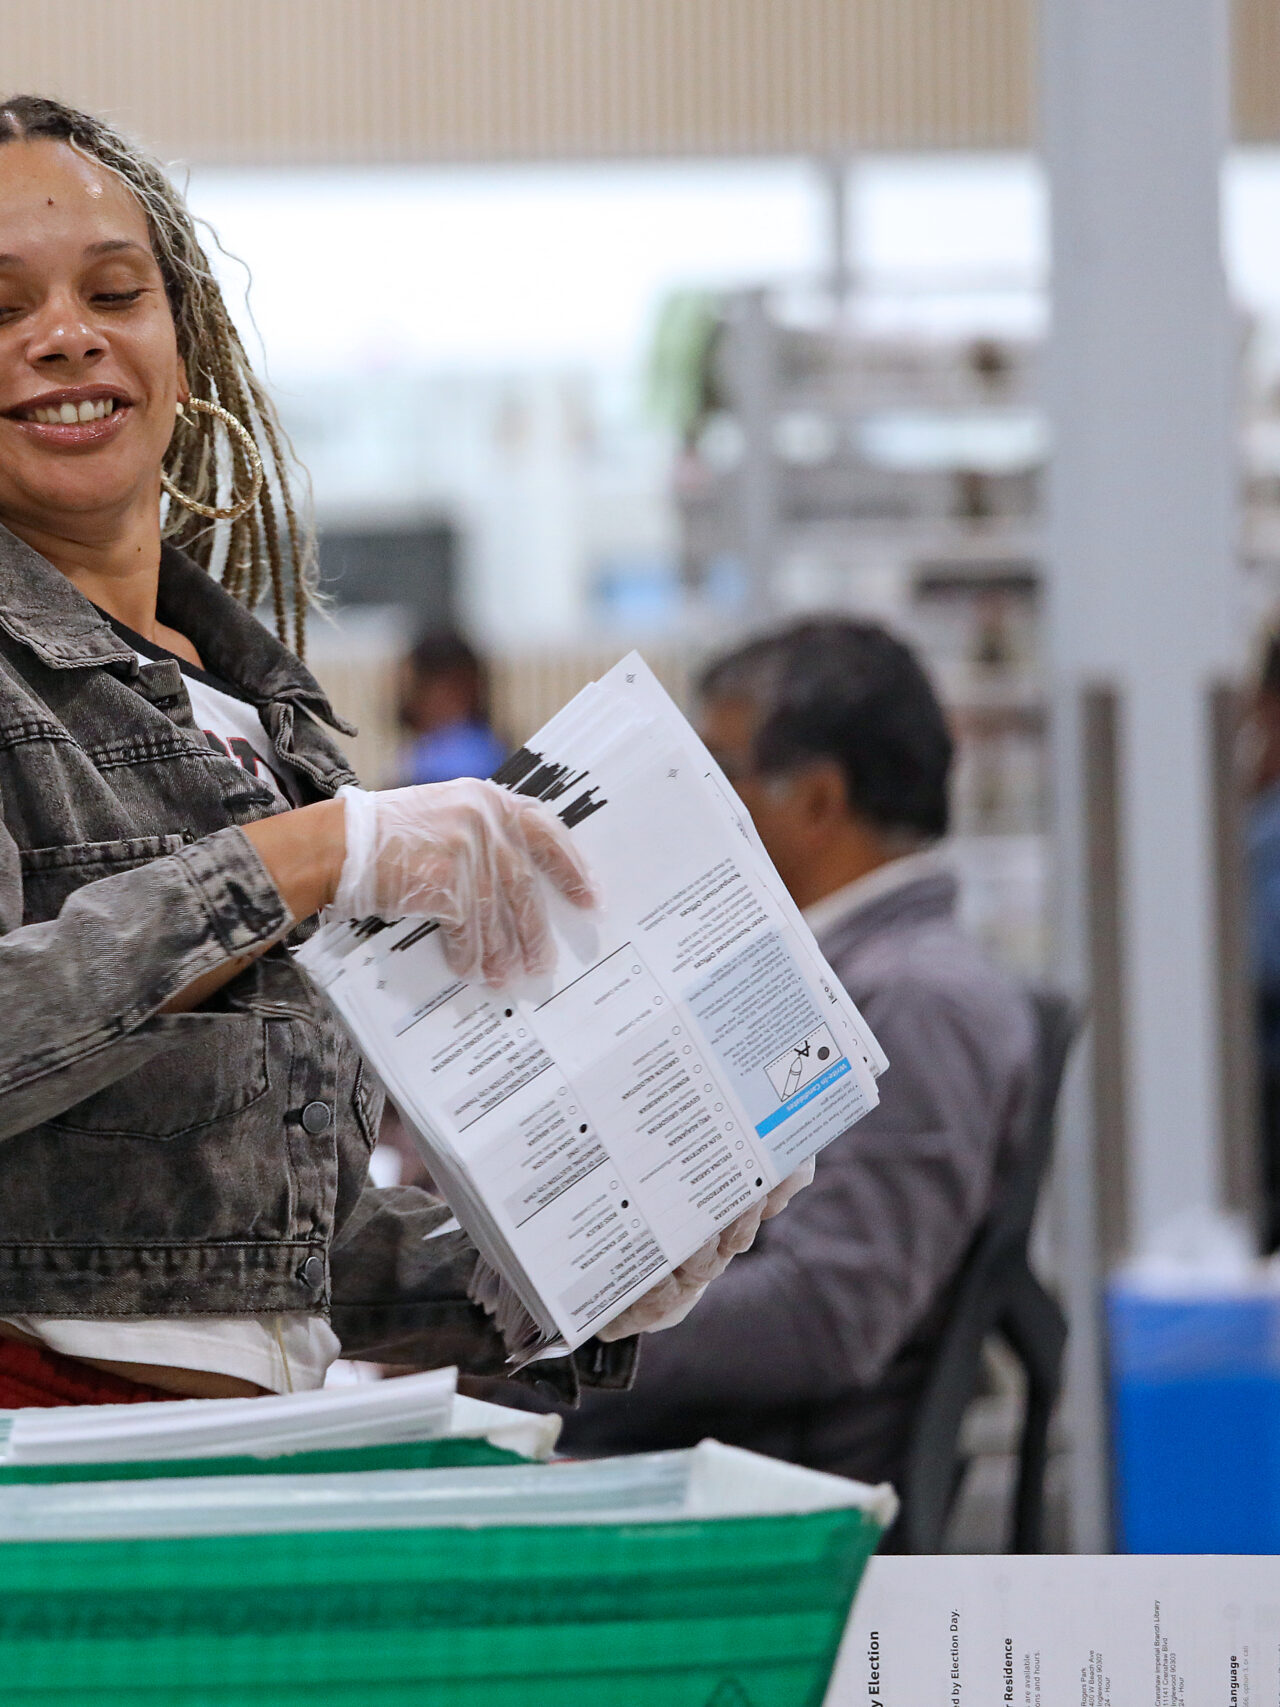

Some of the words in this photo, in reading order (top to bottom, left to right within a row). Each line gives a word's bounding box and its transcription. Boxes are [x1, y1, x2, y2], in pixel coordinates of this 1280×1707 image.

[701, 870, 740, 903] Nonpartisan
[679, 899, 702, 918] Offices
[715, 912, 768, 954] Voter-Nominated
[693, 950, 716, 970] Offices
[819, 1062, 847, 1085] Write-In
[785, 1082, 821, 1112] Candidates
[950, 1609, 959, 1632] Day.
[868, 1631, 879, 1695] Election
[950, 1635, 959, 1678] Election
[1004, 1638, 1013, 1701] Residence
[952, 1682, 961, 1695] by
[1230, 1656, 1239, 1707] Language
